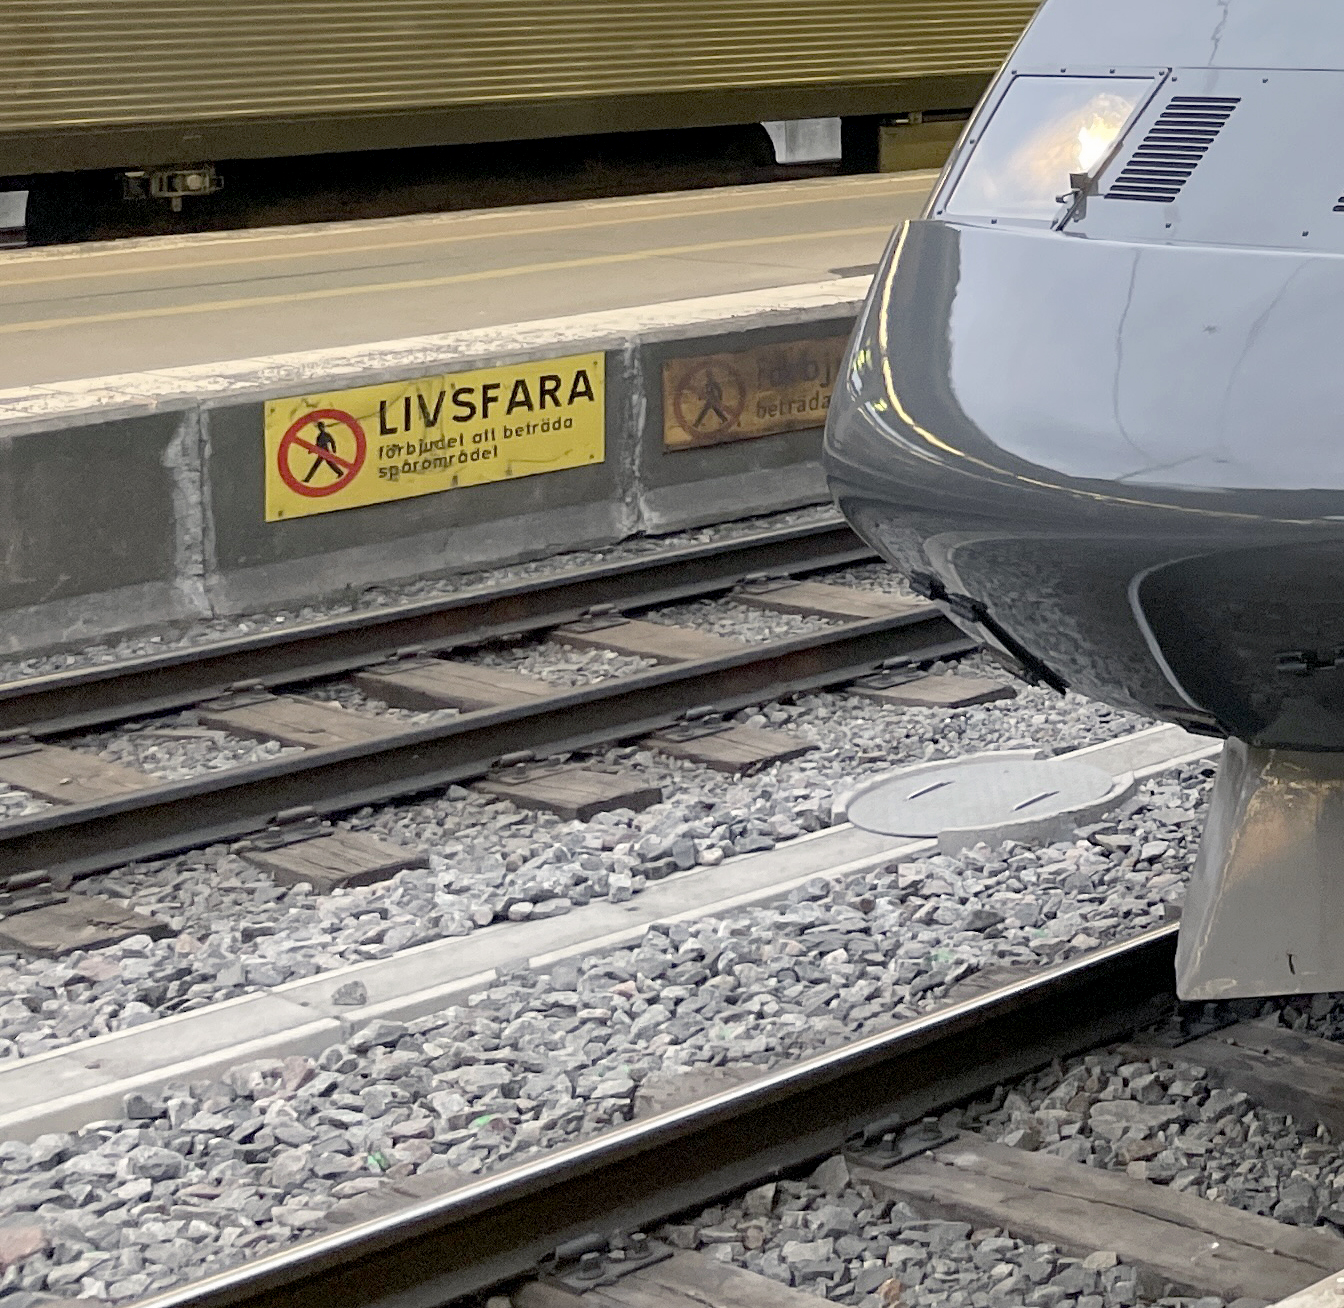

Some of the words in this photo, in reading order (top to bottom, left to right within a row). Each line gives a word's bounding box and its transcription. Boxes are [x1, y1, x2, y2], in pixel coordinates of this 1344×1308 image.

[379, 369, 595, 436] LIVSFARA
[378, 432, 464, 461] förbjudet
[472, 427, 496, 444] att
[503, 416, 574, 440] beträda
[378, 445, 498, 481] spårområdet
